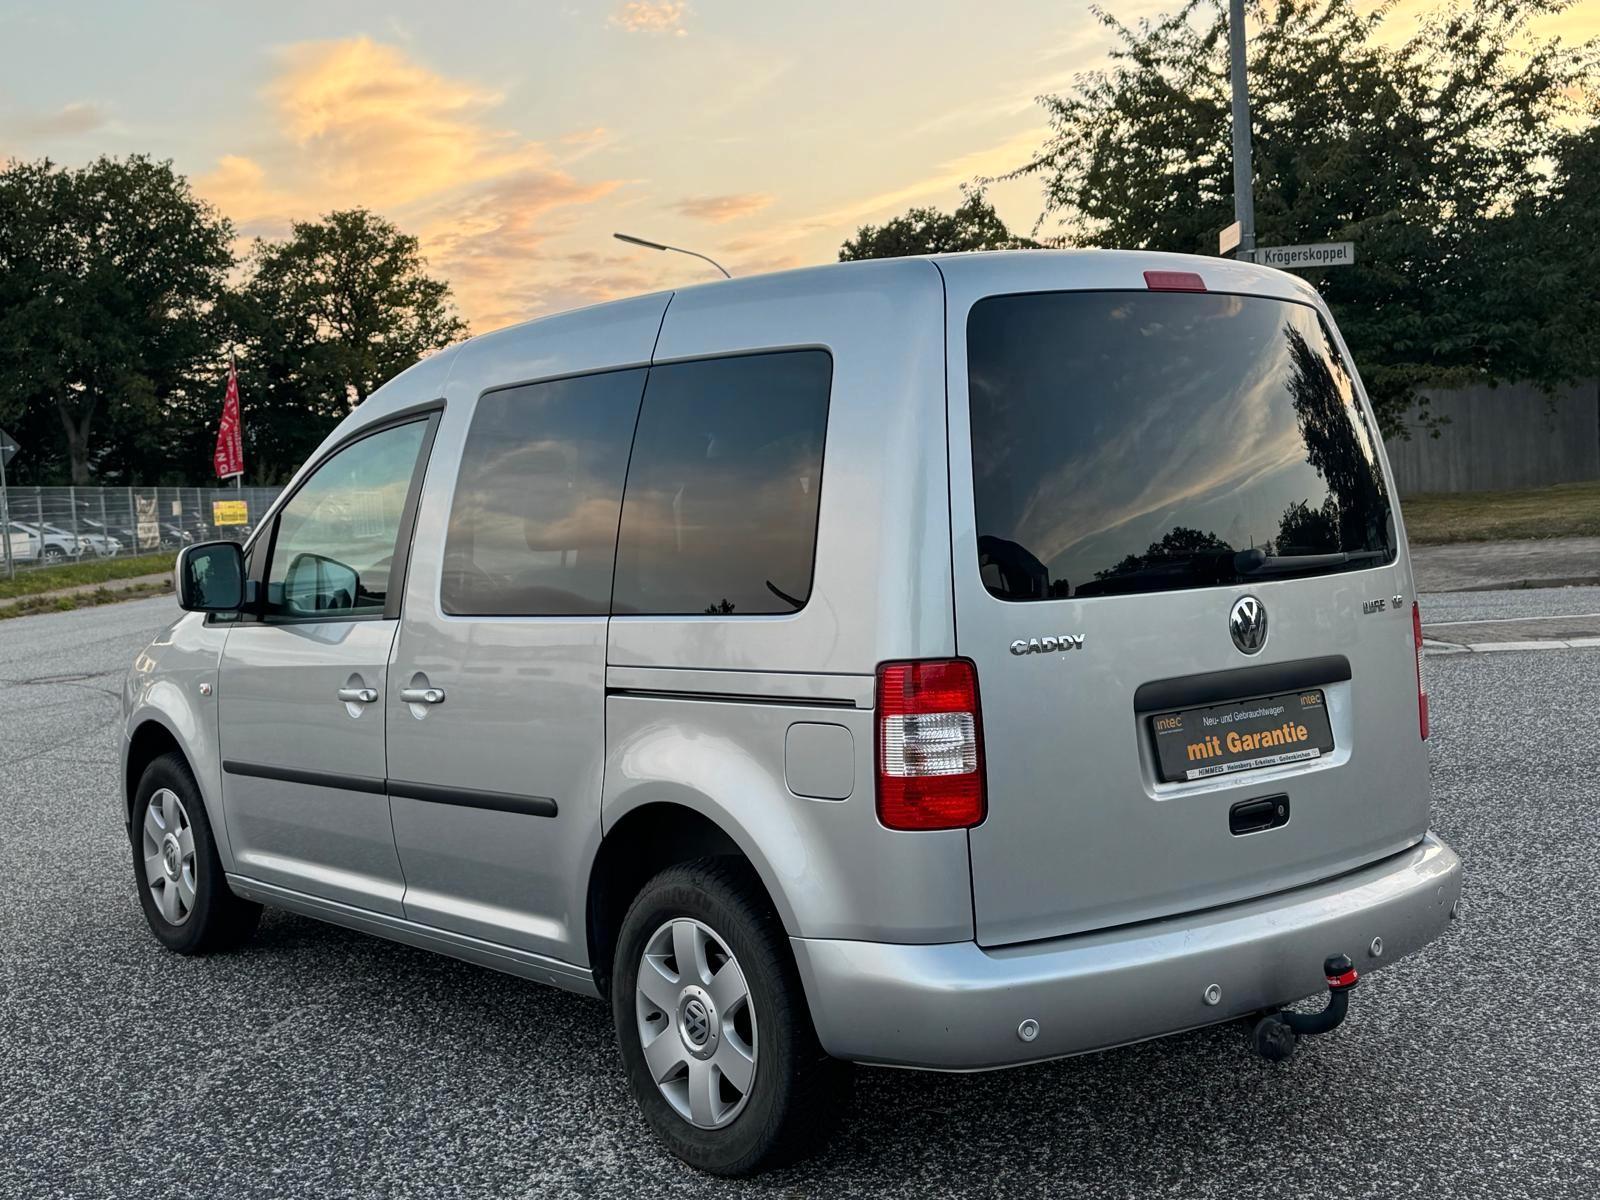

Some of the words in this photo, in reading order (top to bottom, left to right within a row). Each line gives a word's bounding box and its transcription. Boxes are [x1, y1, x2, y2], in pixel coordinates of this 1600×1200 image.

[1265, 246, 1347, 265] Krögerskoppel
[1010, 633, 1086, 656] CADDY
[1203, 716, 1219, 726] Neu-
[1220, 713, 1233, 724] und
[1233, 705, 1285, 721] Gebrauchtwagen
[1187, 735, 1223, 761] mit
[1226, 721, 1309, 753] Garantie
